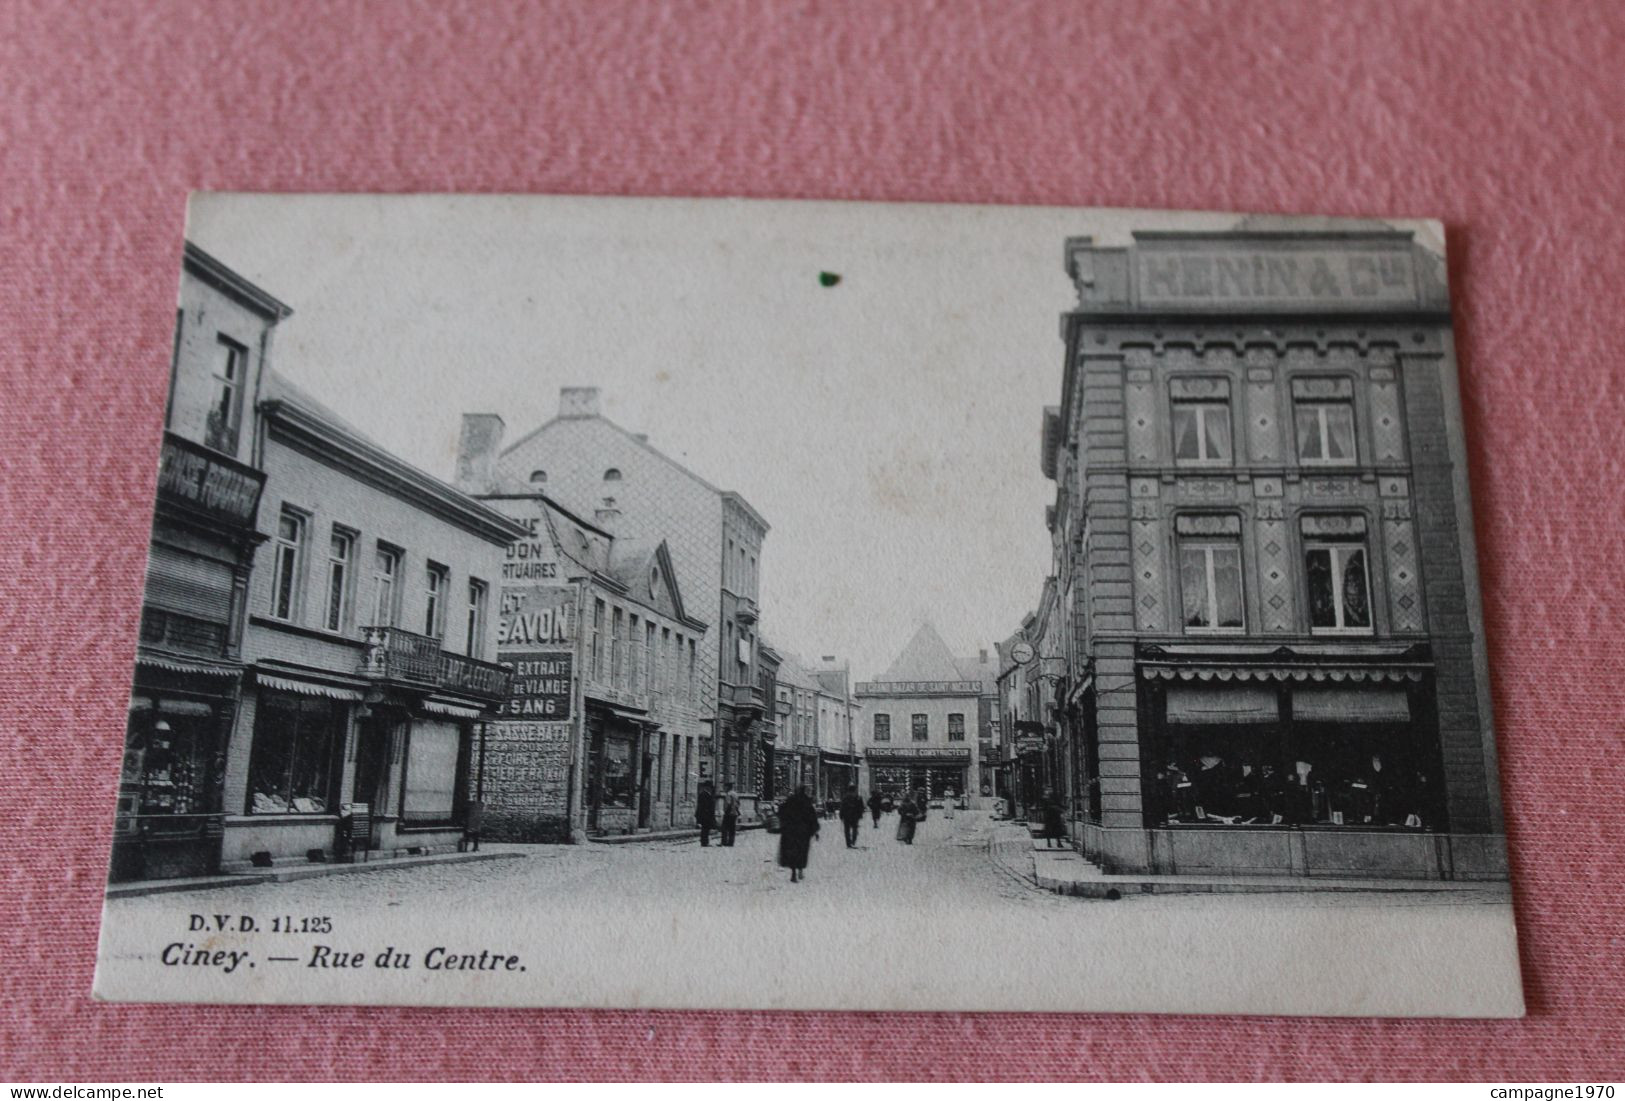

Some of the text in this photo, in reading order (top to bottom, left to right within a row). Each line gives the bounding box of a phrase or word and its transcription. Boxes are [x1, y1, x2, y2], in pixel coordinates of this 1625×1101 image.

[517, 661, 567, 676] EXTRAIT
[525, 679, 569, 695] VIANDE
[510, 699, 556, 715] SANG
[189, 914, 333, 934] D.V.D. 11.125
[160, 942, 256, 974] Ciney.
[307, 945, 365, 969] Rue
[374, 945, 411, 971] du
[423, 947, 527, 973] Centre.
